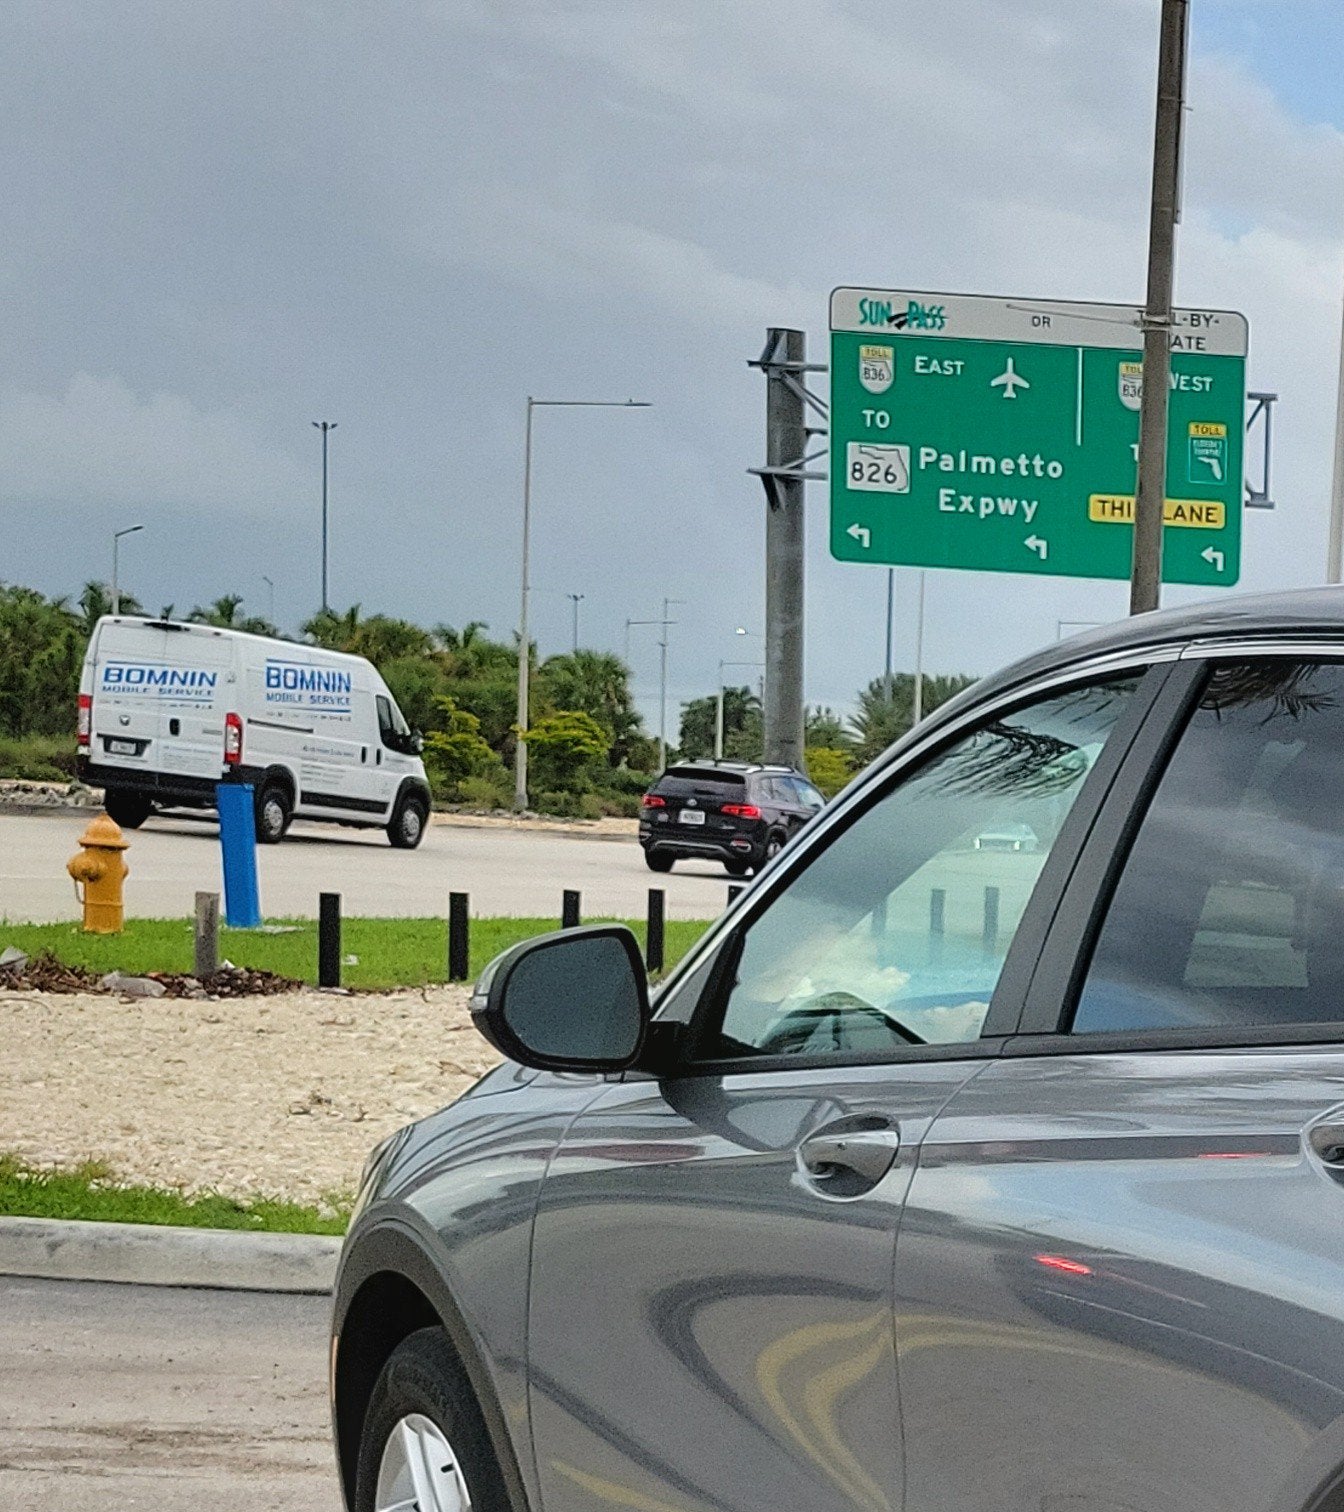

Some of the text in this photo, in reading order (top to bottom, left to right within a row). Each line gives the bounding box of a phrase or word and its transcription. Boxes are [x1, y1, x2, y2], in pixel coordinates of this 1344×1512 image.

[1032, 315, 1050, 328] OR
[915, 356, 964, 375] EAST
[862, 409, 890, 428] TO
[851, 447, 1063, 483] 826 Palmetto
[939, 488, 1038, 523] Expwy
[1097, 500, 1131, 517] THI
[103, 667, 217, 687] BOMNIN
[266, 667, 351, 693] BOMNIN
[102, 686, 213, 696] MOBILE SERVICE
[266, 693, 351, 705] MOBILE SERVICE
